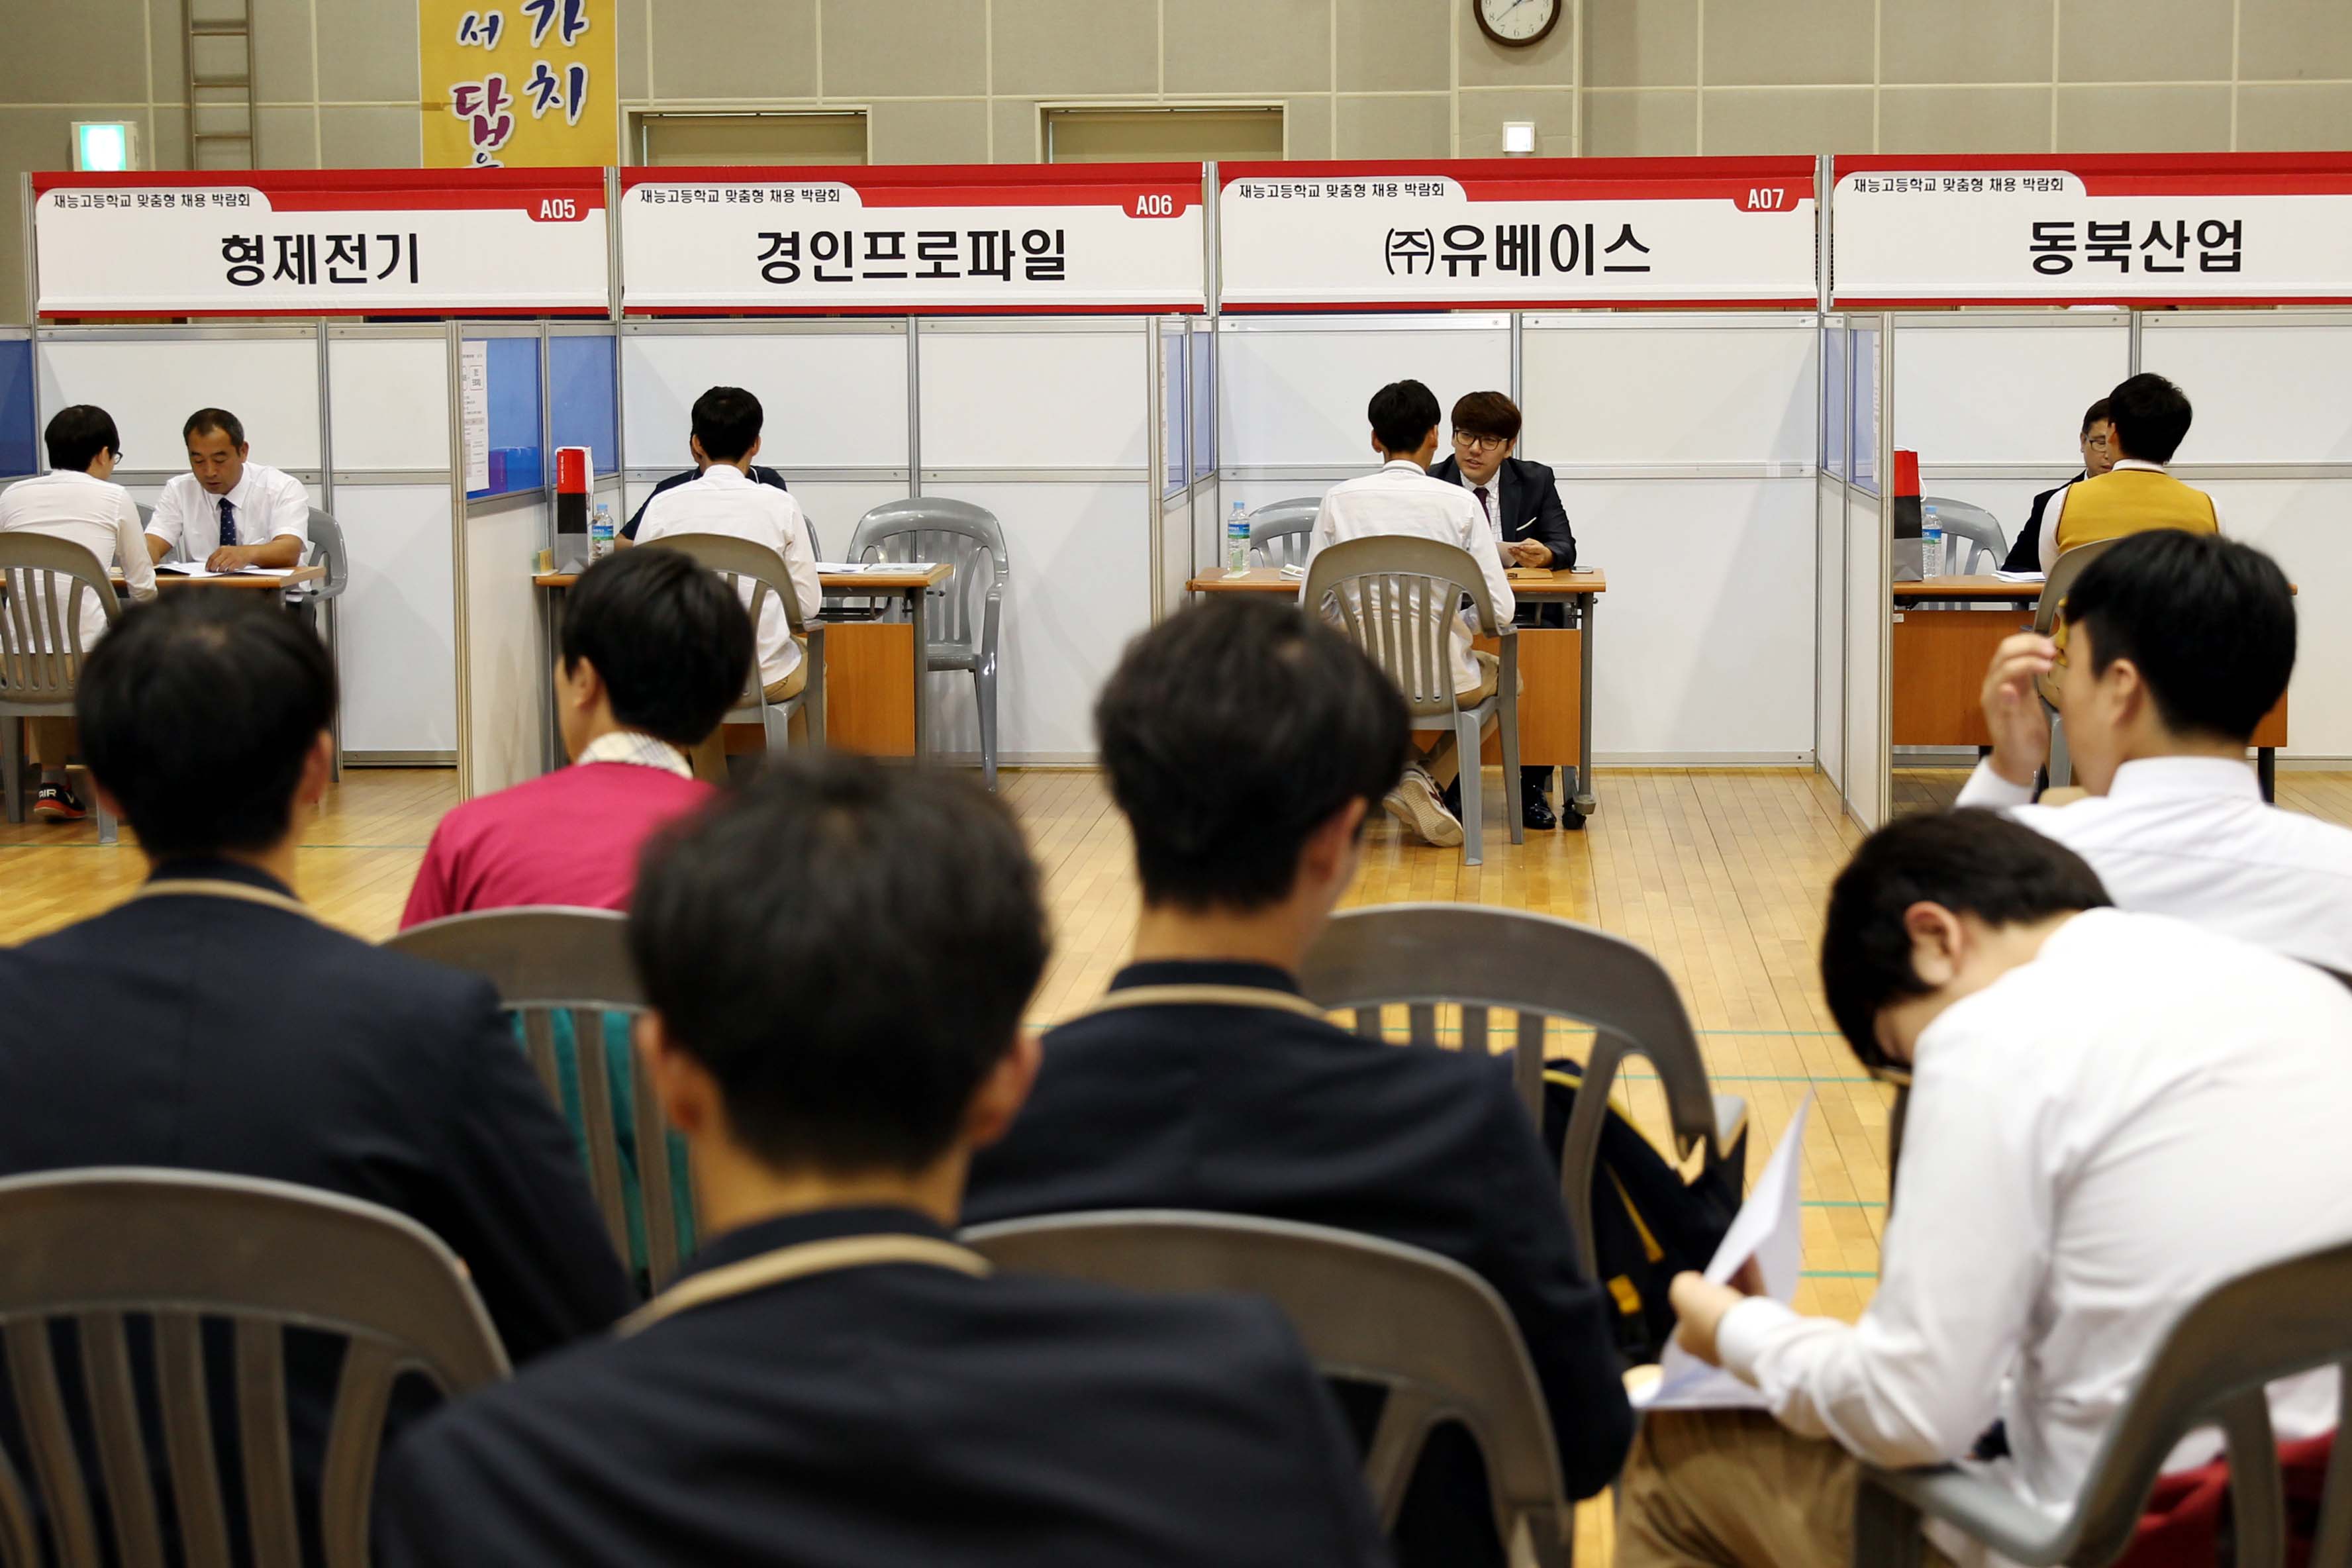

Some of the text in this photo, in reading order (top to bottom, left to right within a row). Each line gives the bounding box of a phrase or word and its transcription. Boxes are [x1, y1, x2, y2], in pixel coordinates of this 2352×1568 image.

[1240, 183, 1444, 198] 재능고등학교 맞춤형 채용 박람회
[1854, 178, 2063, 193] 재능고등학교 맞춤형 채용 박람회
[54, 193, 250, 208] 재능고등학교 맞춤형 채용 박람회
[641, 189, 840, 203] 재능고등학교 맞춤형 채용 박람회
[1136, 195, 1172, 215] A06
[1748, 189, 1784, 209] A07
[540, 199, 575, 219] A05
[758, 229, 1065, 284] 경인프로파일
[2030, 220, 2242, 275] 동북산업
[222, 233, 418, 287] 형제전기
